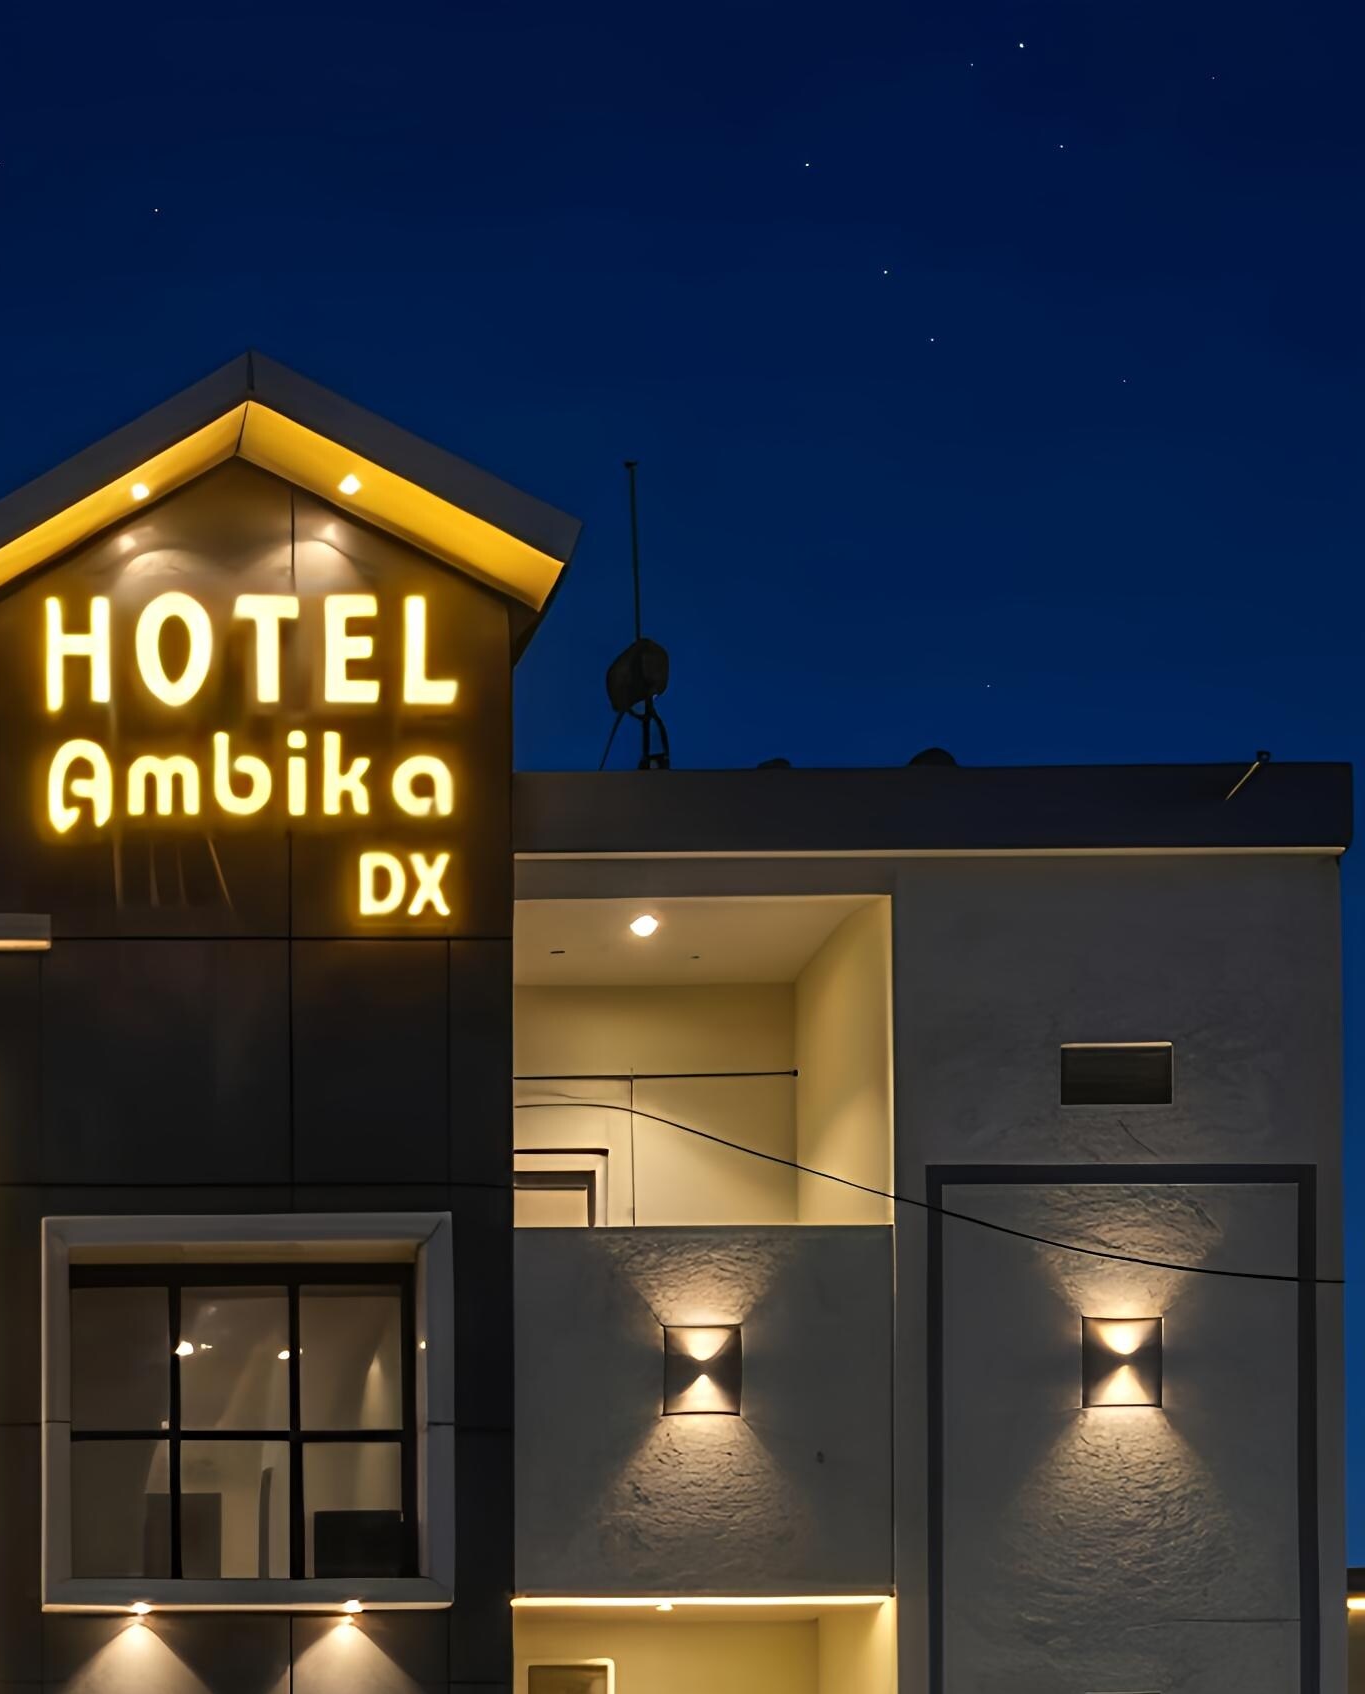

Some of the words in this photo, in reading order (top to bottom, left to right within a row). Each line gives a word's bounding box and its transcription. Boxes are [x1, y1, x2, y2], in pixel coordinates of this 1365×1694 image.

[44, 591, 459, 713] HOTEL
[46, 729, 455, 835] Ambika
[358, 851, 451, 917] DX
